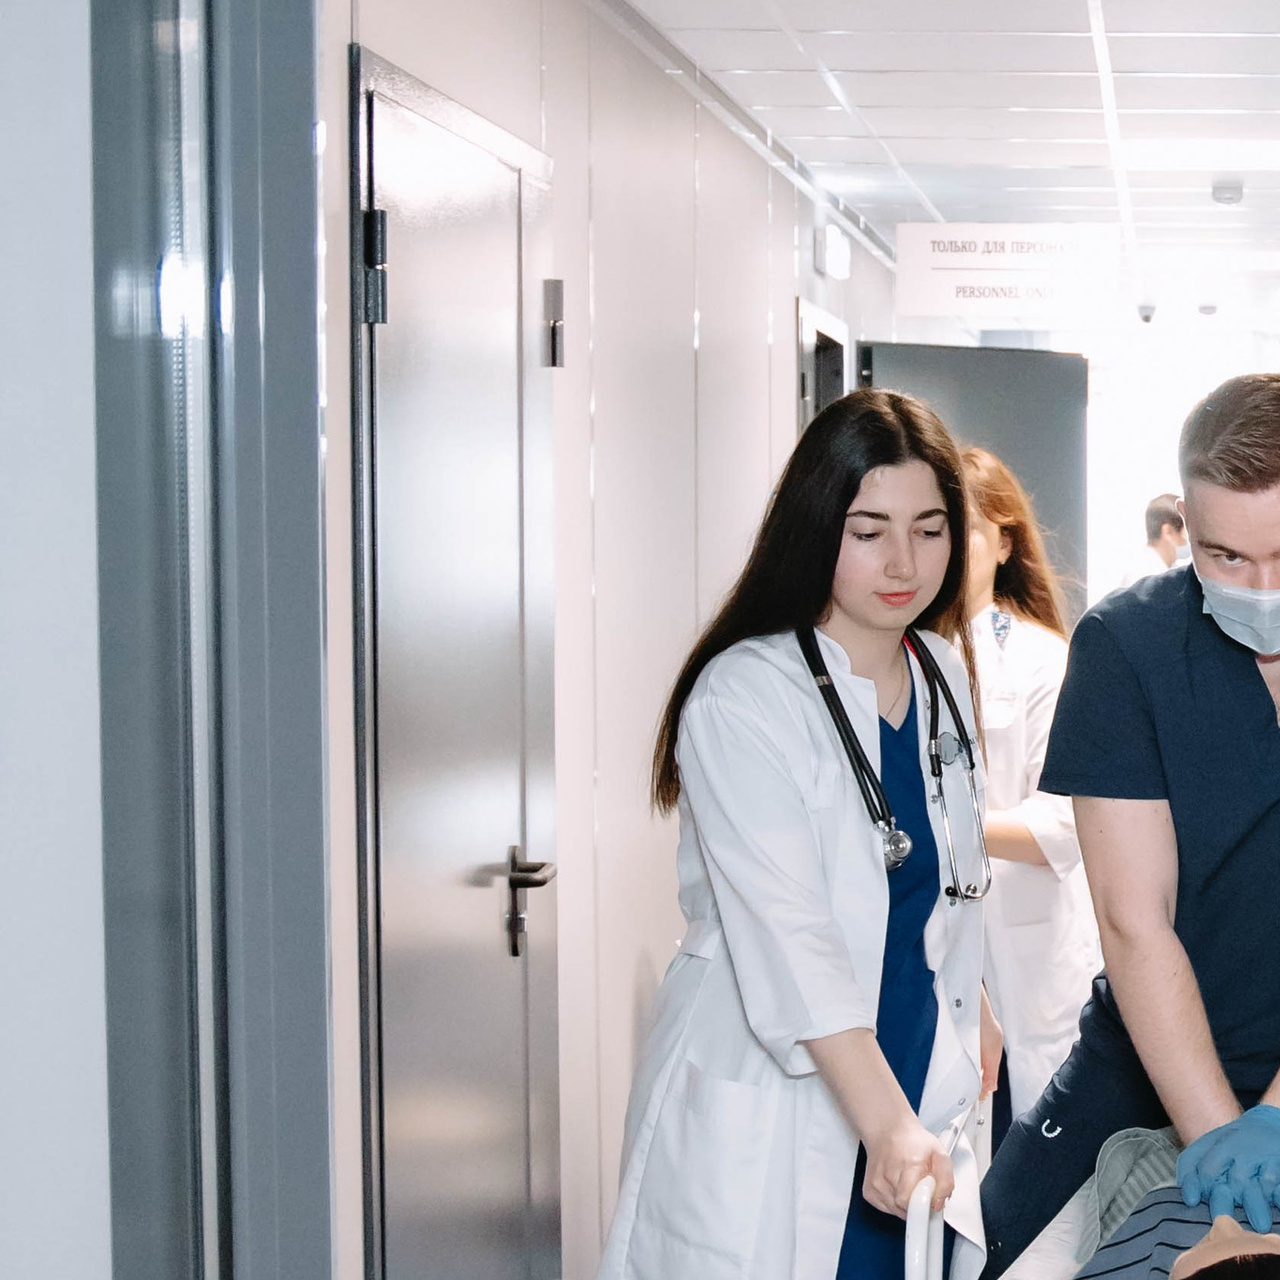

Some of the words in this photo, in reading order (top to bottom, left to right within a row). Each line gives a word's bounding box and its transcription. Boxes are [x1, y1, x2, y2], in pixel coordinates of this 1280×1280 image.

[930, 240, 977, 253] ТОЛЬКО
[982, 241, 1005, 254] ДЛЯ
[955, 286, 1020, 299] PERSONNEL
